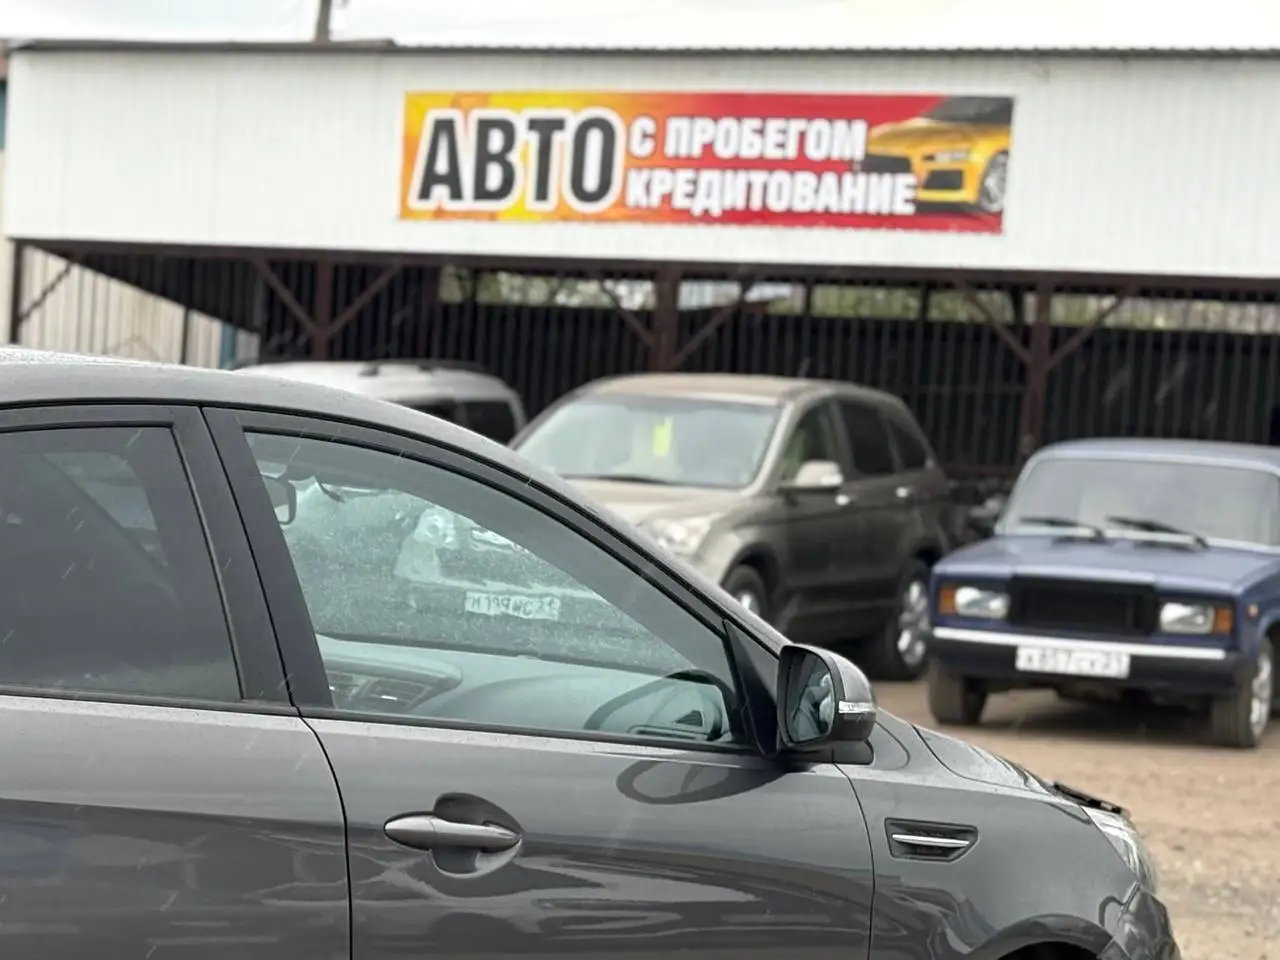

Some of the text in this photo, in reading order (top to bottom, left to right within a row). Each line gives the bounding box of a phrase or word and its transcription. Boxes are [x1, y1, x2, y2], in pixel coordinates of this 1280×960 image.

[417, 114, 619, 204] АВТО
[665, 117, 868, 161] ПРОБЕГОМ
[627, 170, 917, 216] КРЕДИТОВАНИЕ
